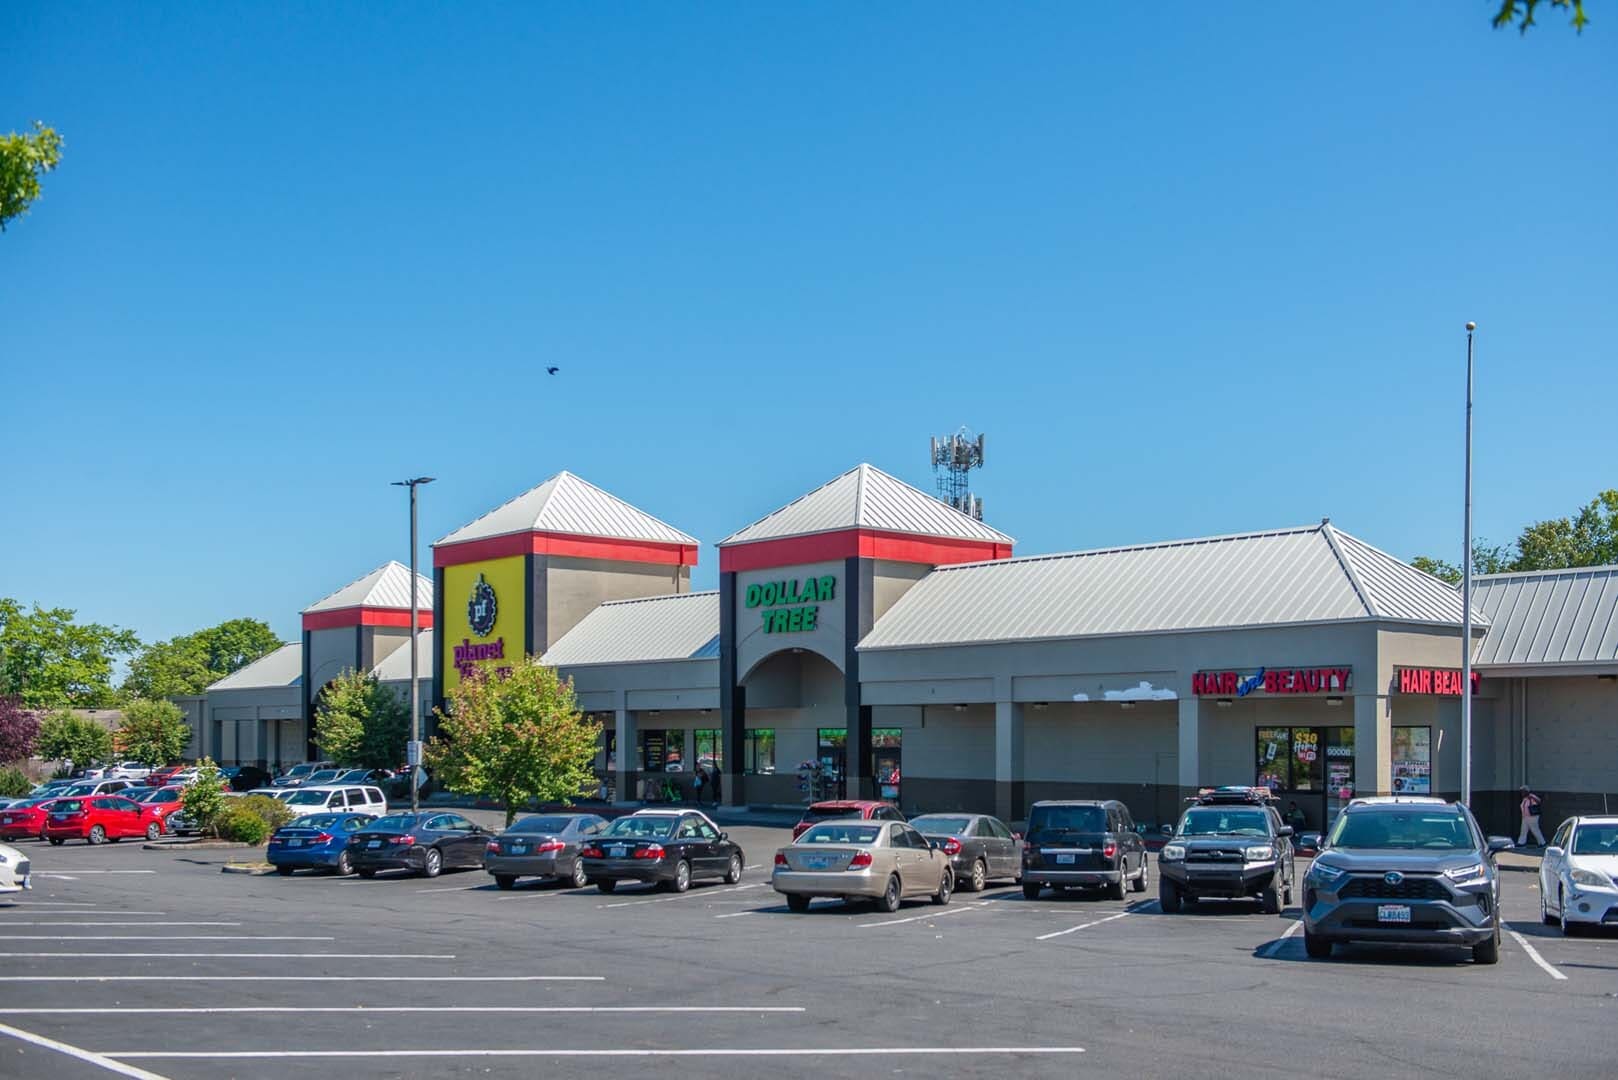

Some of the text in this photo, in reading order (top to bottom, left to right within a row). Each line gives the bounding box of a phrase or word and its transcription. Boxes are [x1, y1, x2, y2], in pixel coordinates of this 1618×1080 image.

[745, 575, 836, 608] DOLLAR
[474, 600, 487, 622] pf
[761, 606, 818, 634] TREE
[454, 637, 504, 668] planet
[1192, 671, 1238, 695] HAIR
[1264, 668, 1350, 694] BEAUTY
[1400, 669, 1481, 696] HAIR BEAUY
[1296, 733, 1318, 744] $30
